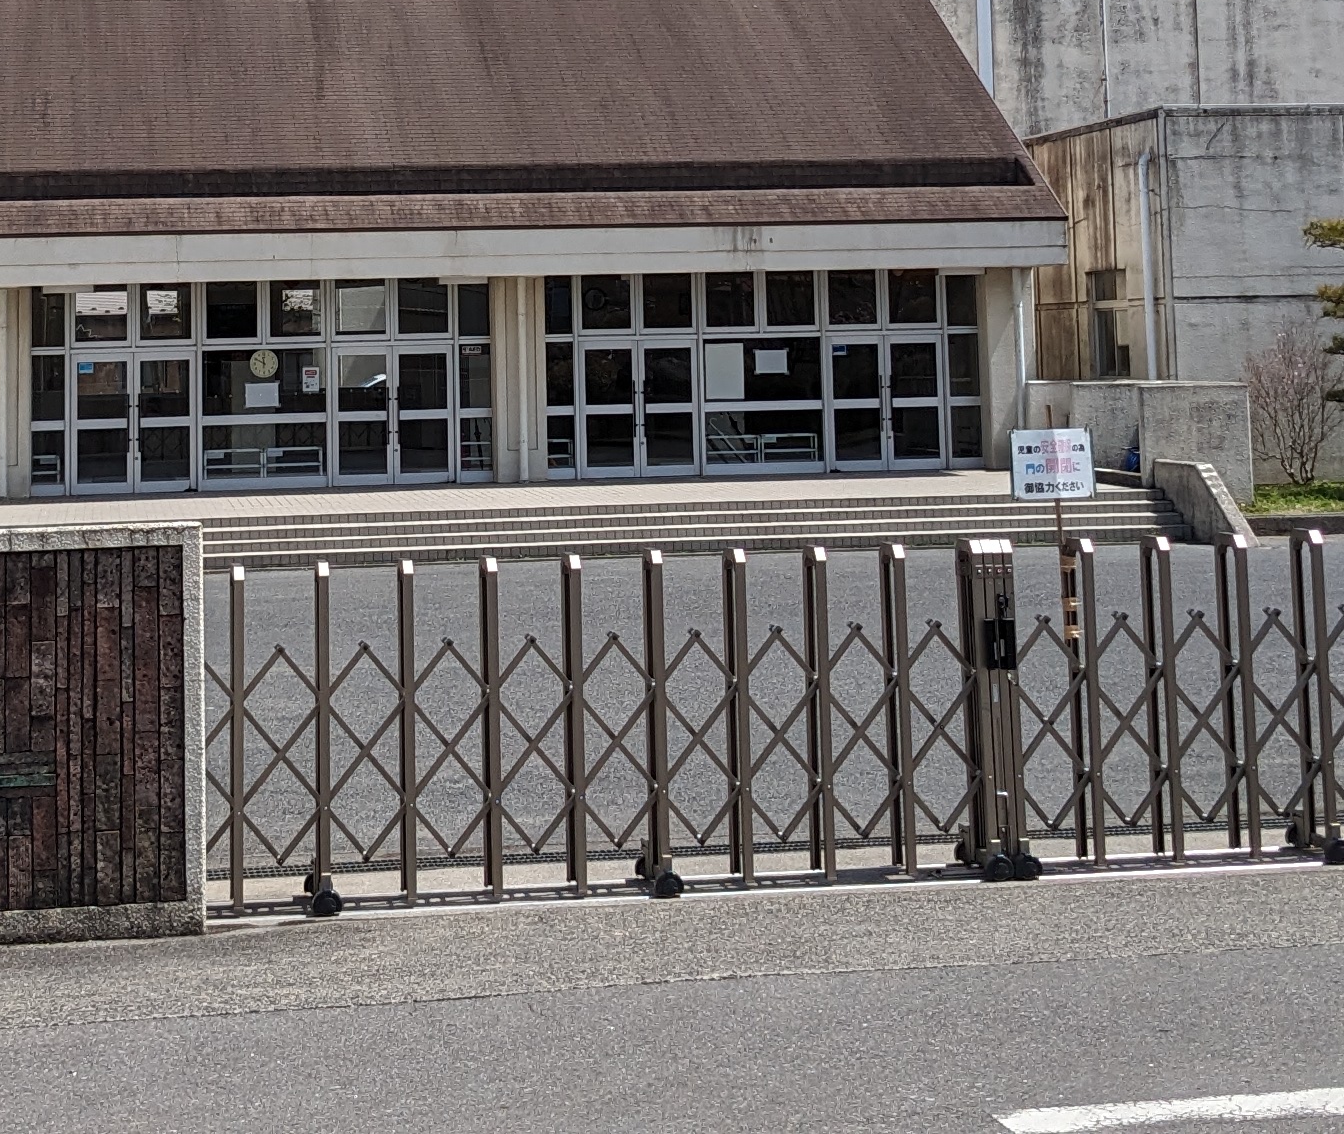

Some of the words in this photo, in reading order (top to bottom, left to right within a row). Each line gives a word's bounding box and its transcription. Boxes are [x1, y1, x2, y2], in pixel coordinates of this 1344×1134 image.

[1025, 458, 1080, 474] 門の開閉に
[1024, 481, 1084, 494] 御協力ください
